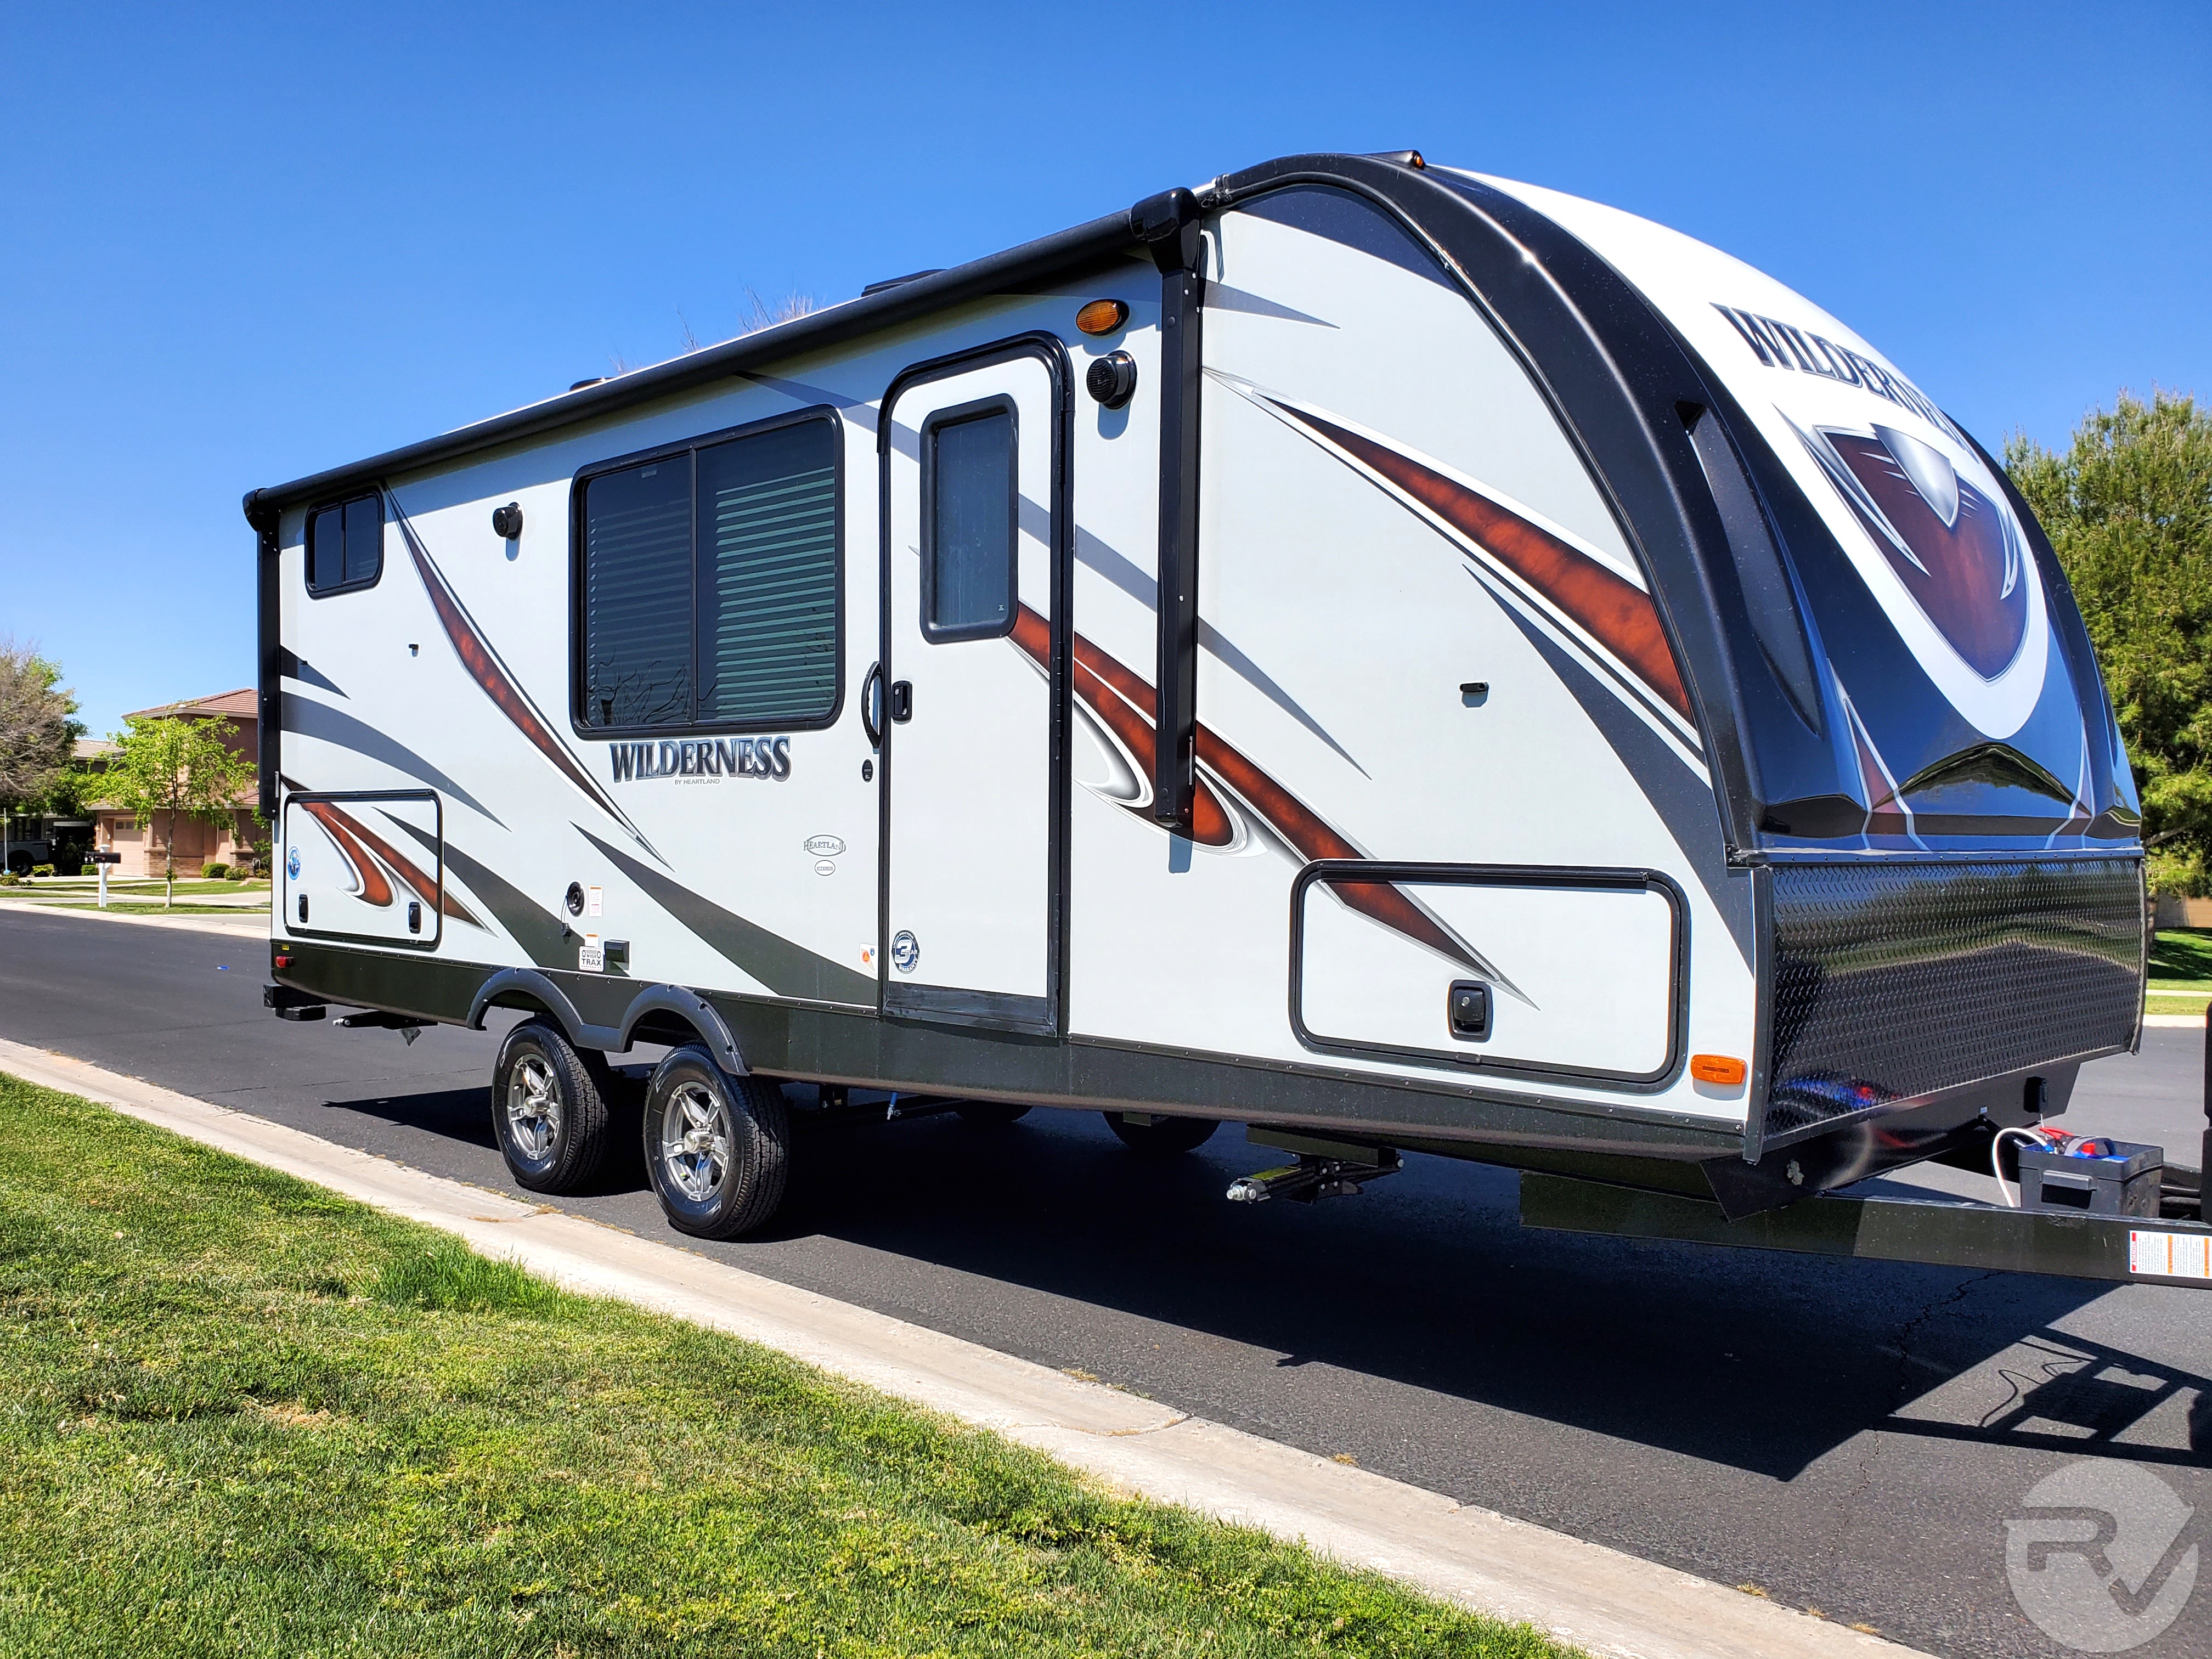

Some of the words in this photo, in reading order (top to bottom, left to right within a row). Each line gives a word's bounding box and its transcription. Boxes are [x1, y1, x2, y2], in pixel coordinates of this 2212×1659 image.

[610, 736, 791, 783] WILDERNESS
[803, 840, 847, 852] HEARTLAND
[895, 939, 913, 964] 3
